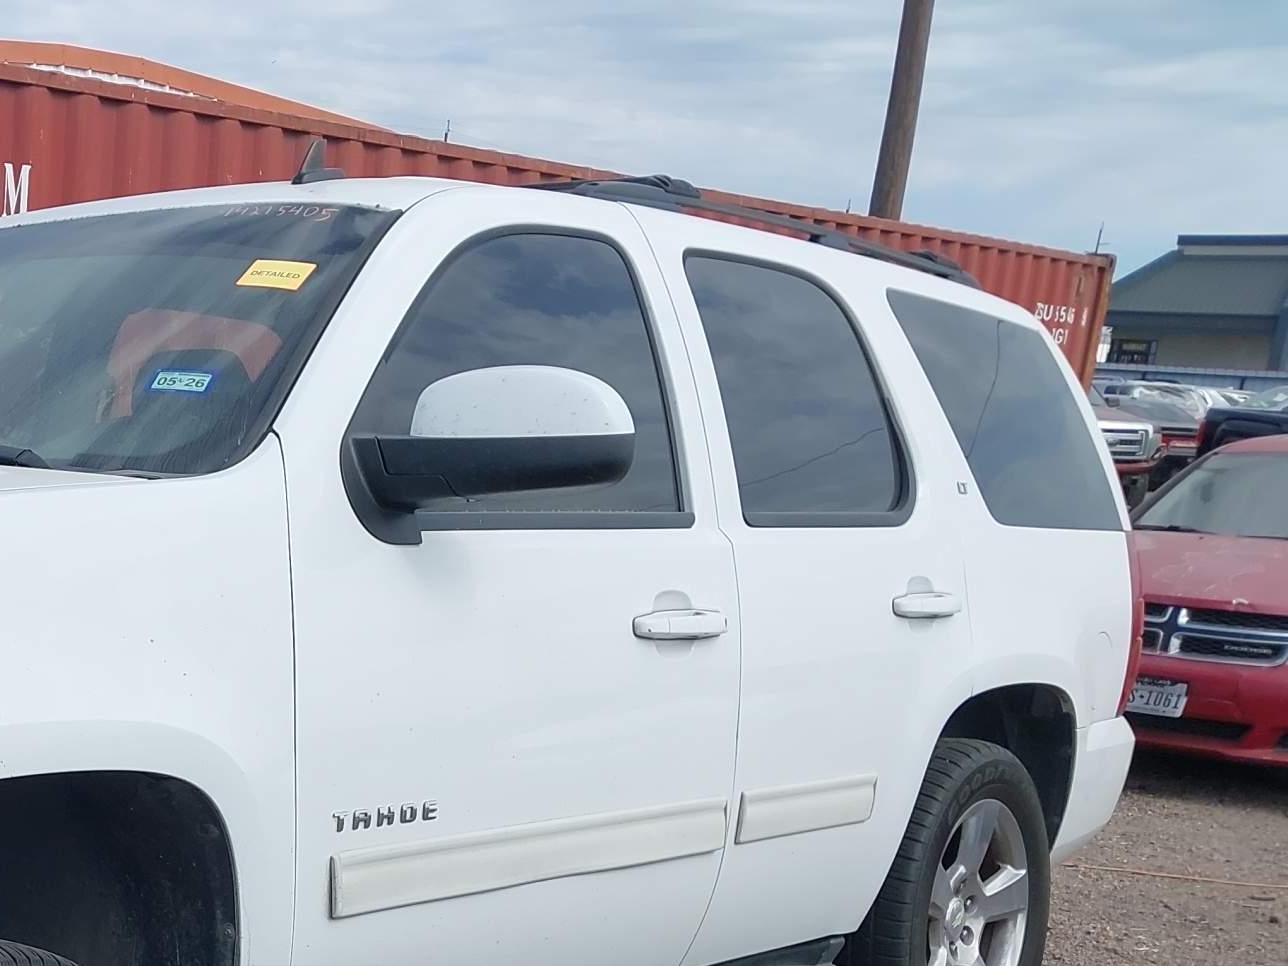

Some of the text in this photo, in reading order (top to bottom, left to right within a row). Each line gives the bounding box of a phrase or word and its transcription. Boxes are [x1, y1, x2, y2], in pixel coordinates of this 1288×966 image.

[250, 270, 300, 279] DETAILED
[957, 481, 968, 494] LT
[332, 800, 438, 832] TAHOE
